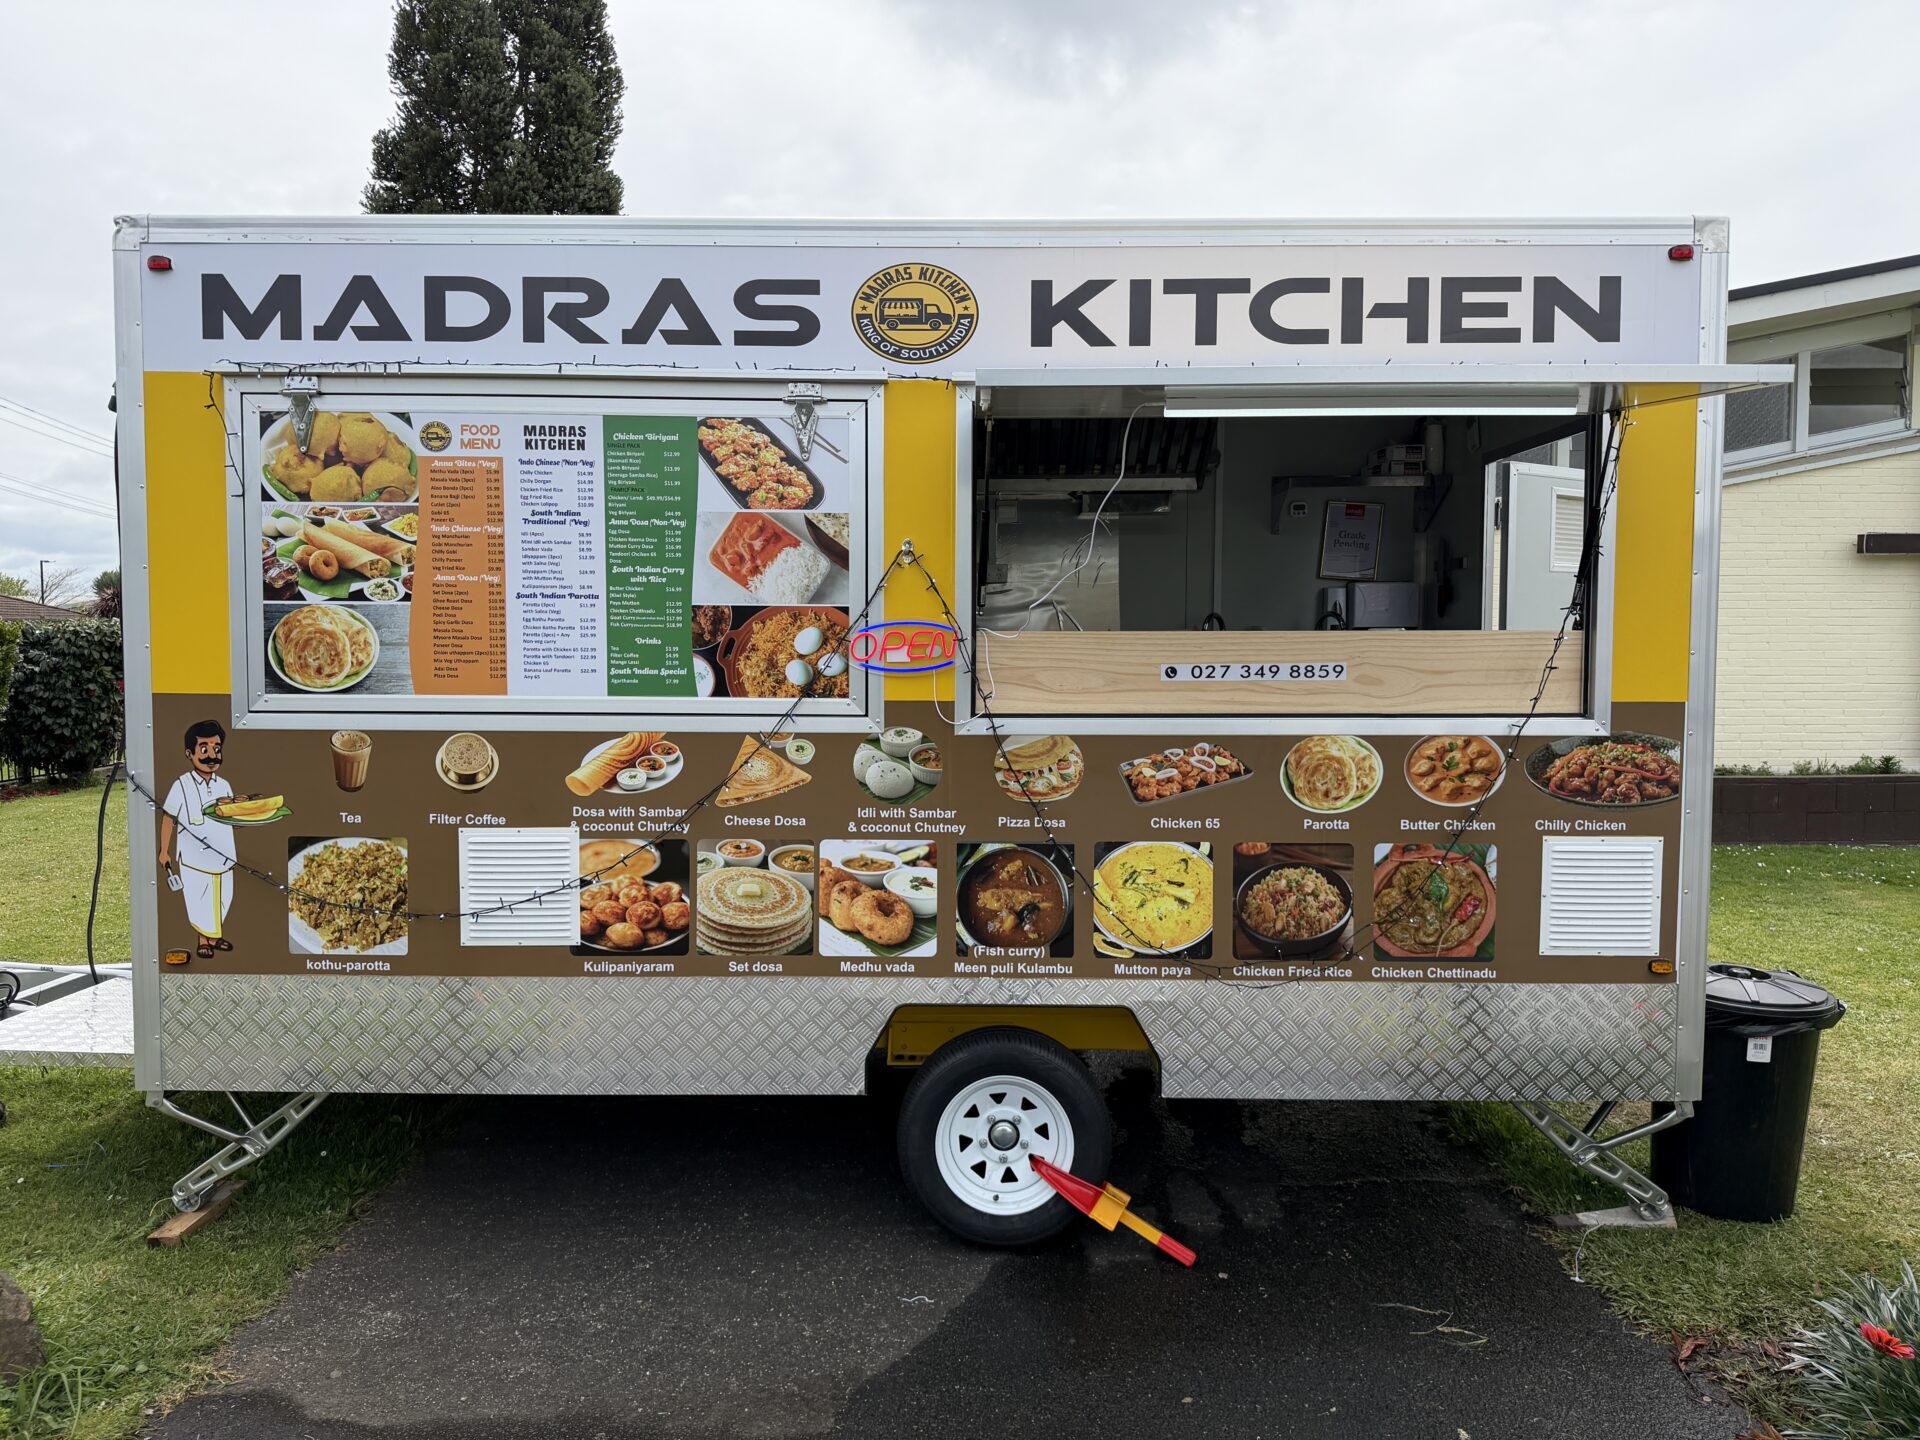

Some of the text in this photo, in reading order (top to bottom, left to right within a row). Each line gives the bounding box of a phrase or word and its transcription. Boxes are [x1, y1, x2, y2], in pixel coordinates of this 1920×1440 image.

[859, 267, 972, 304] MADRAS KITCHEN
[201, 273, 821, 347] MADRAS
[1031, 275, 1622, 347] KITCHEN
[860, 318, 971, 358] KING OF SOUTH INDIA
[460, 425, 500, 435] FOOD
[524, 425, 586, 437] MADRAS
[460, 439, 500, 449] MENU
[525, 439, 585, 450] KITCHEN
[645, 434, 678, 442] Biriyani
[561, 460, 595, 468] (Non-Veg)
[650, 520, 686, 528] (Non-Veg)
[1338, 530, 1366, 541] Grade
[1333, 538, 1370, 551] Pending
[480, 575, 500, 583] (Veg)
[851, 631, 958, 662] OPEN
[1191, 664, 1345, 679] 027 349 8859
[339, 812, 362, 824] Tea
[572, 806, 688, 818] Dosa with Sambar
[857, 807, 957, 819] Idli with Sambar
[429, 813, 506, 826] Filter Coffee
[724, 814, 806, 827] Cheese Dosa
[998, 816, 1066, 828] Pizza Dosa
[1150, 817, 1221, 829] Chicken 65
[1303, 818, 1350, 830] Parotta
[1400, 819, 1441, 831] Butter
[1534, 819, 1627, 832] Chilly Chicken
[582, 821, 635, 832] coconut
[848, 821, 966, 835] & coconut Chutney
[973, 946, 1045, 959] (Fish curry)
[306, 959, 391, 973] kothu-parotta
[583, 961, 675, 975] Kulipaniyaram
[728, 960, 783, 973] Set dosa
[840, 961, 915, 973] Medhu vada
[954, 962, 1073, 976] Meen puli Kulambu
[1113, 963, 1192, 979] Mutton paya
[1232, 965, 1353, 978] Chicken Fried Rice
[1371, 966, 1497, 979] Chicken Chettinadu
